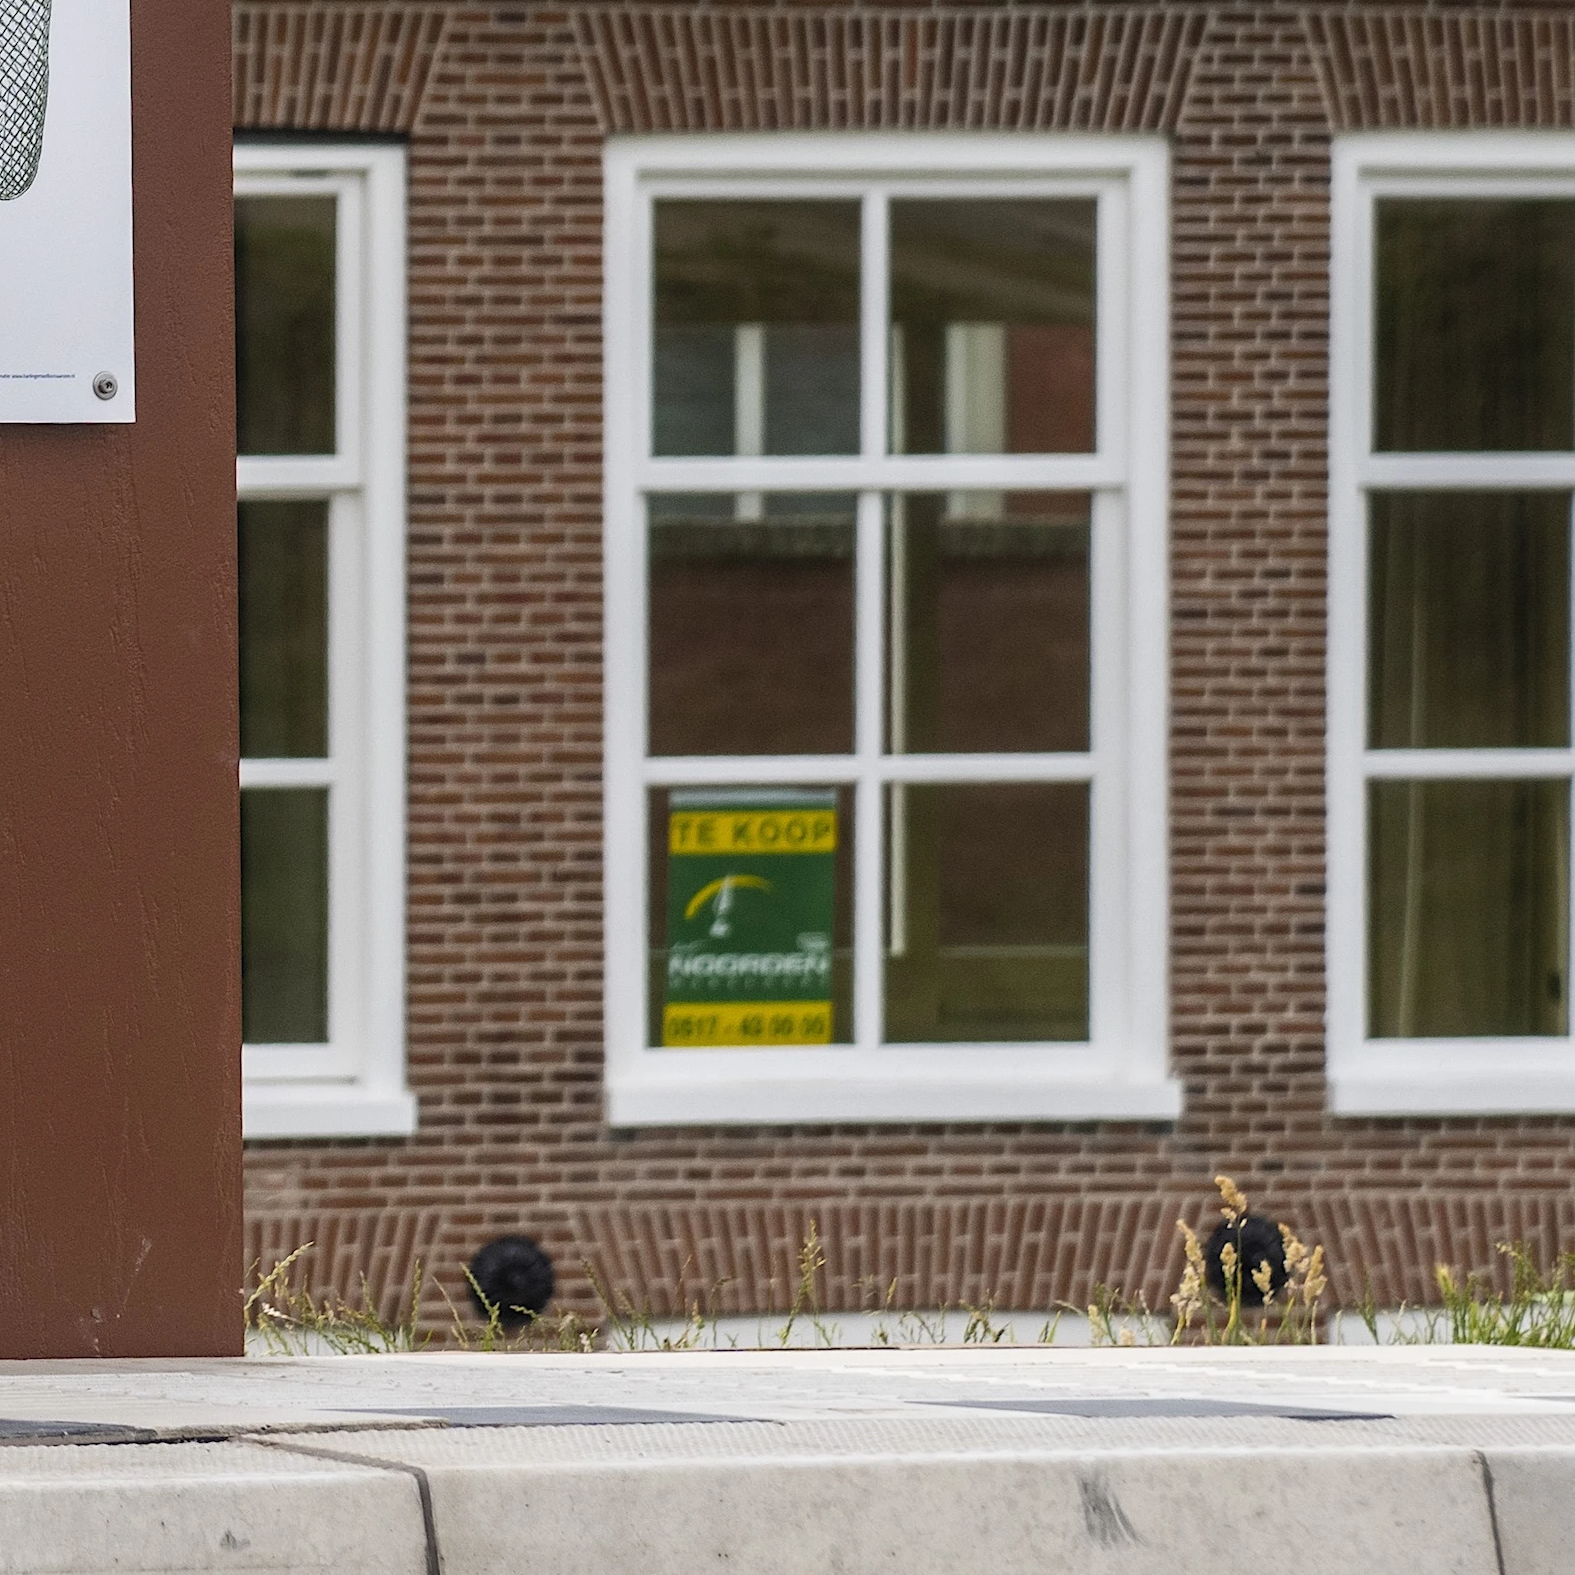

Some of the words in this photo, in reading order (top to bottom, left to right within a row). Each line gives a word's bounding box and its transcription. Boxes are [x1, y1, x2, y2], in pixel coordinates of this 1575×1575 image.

[677, 817, 718, 844] TE
[732, 816, 831, 844] KOOP
[668, 951, 830, 976] NOORDEN
